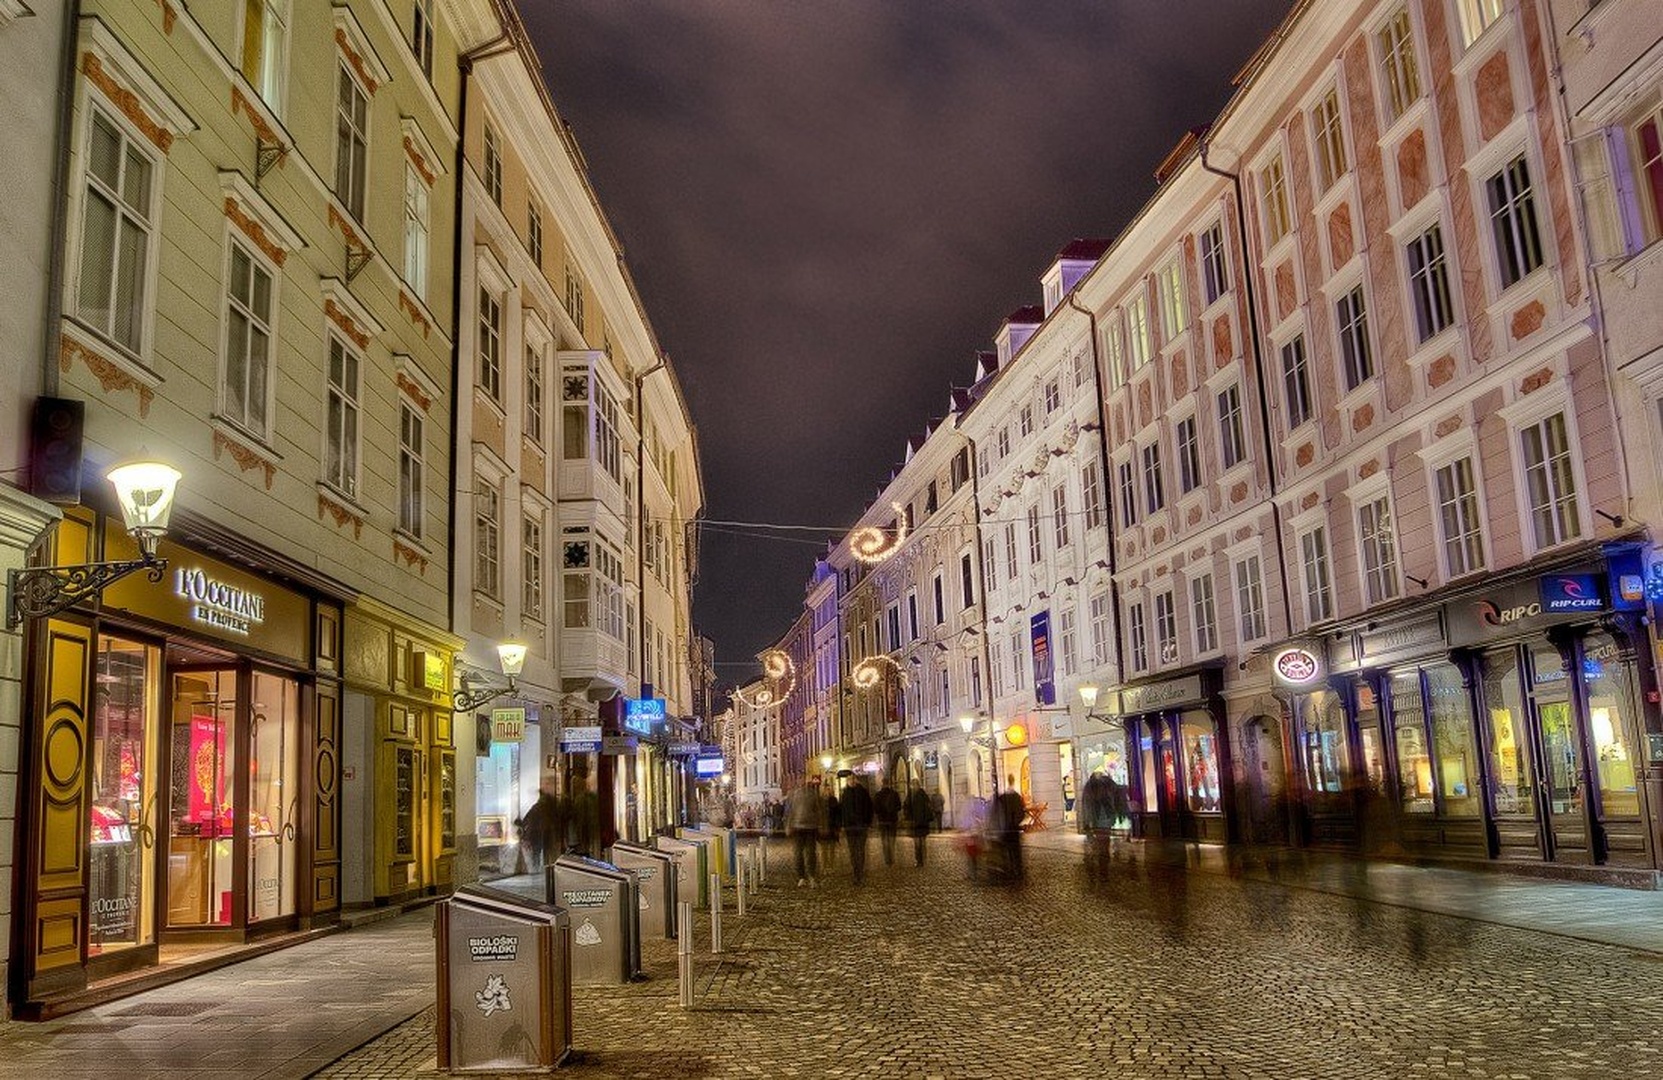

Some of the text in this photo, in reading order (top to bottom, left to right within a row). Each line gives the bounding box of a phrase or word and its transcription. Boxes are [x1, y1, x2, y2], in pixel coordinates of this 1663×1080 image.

[1550, 599, 1603, 608] RIP CURL
[1500, 606, 1526, 624] RIP
[496, 722, 520, 738] MAK
[469, 935, 518, 946] BIOLOŠKI
[471, 945, 516, 954] ODPADKI
